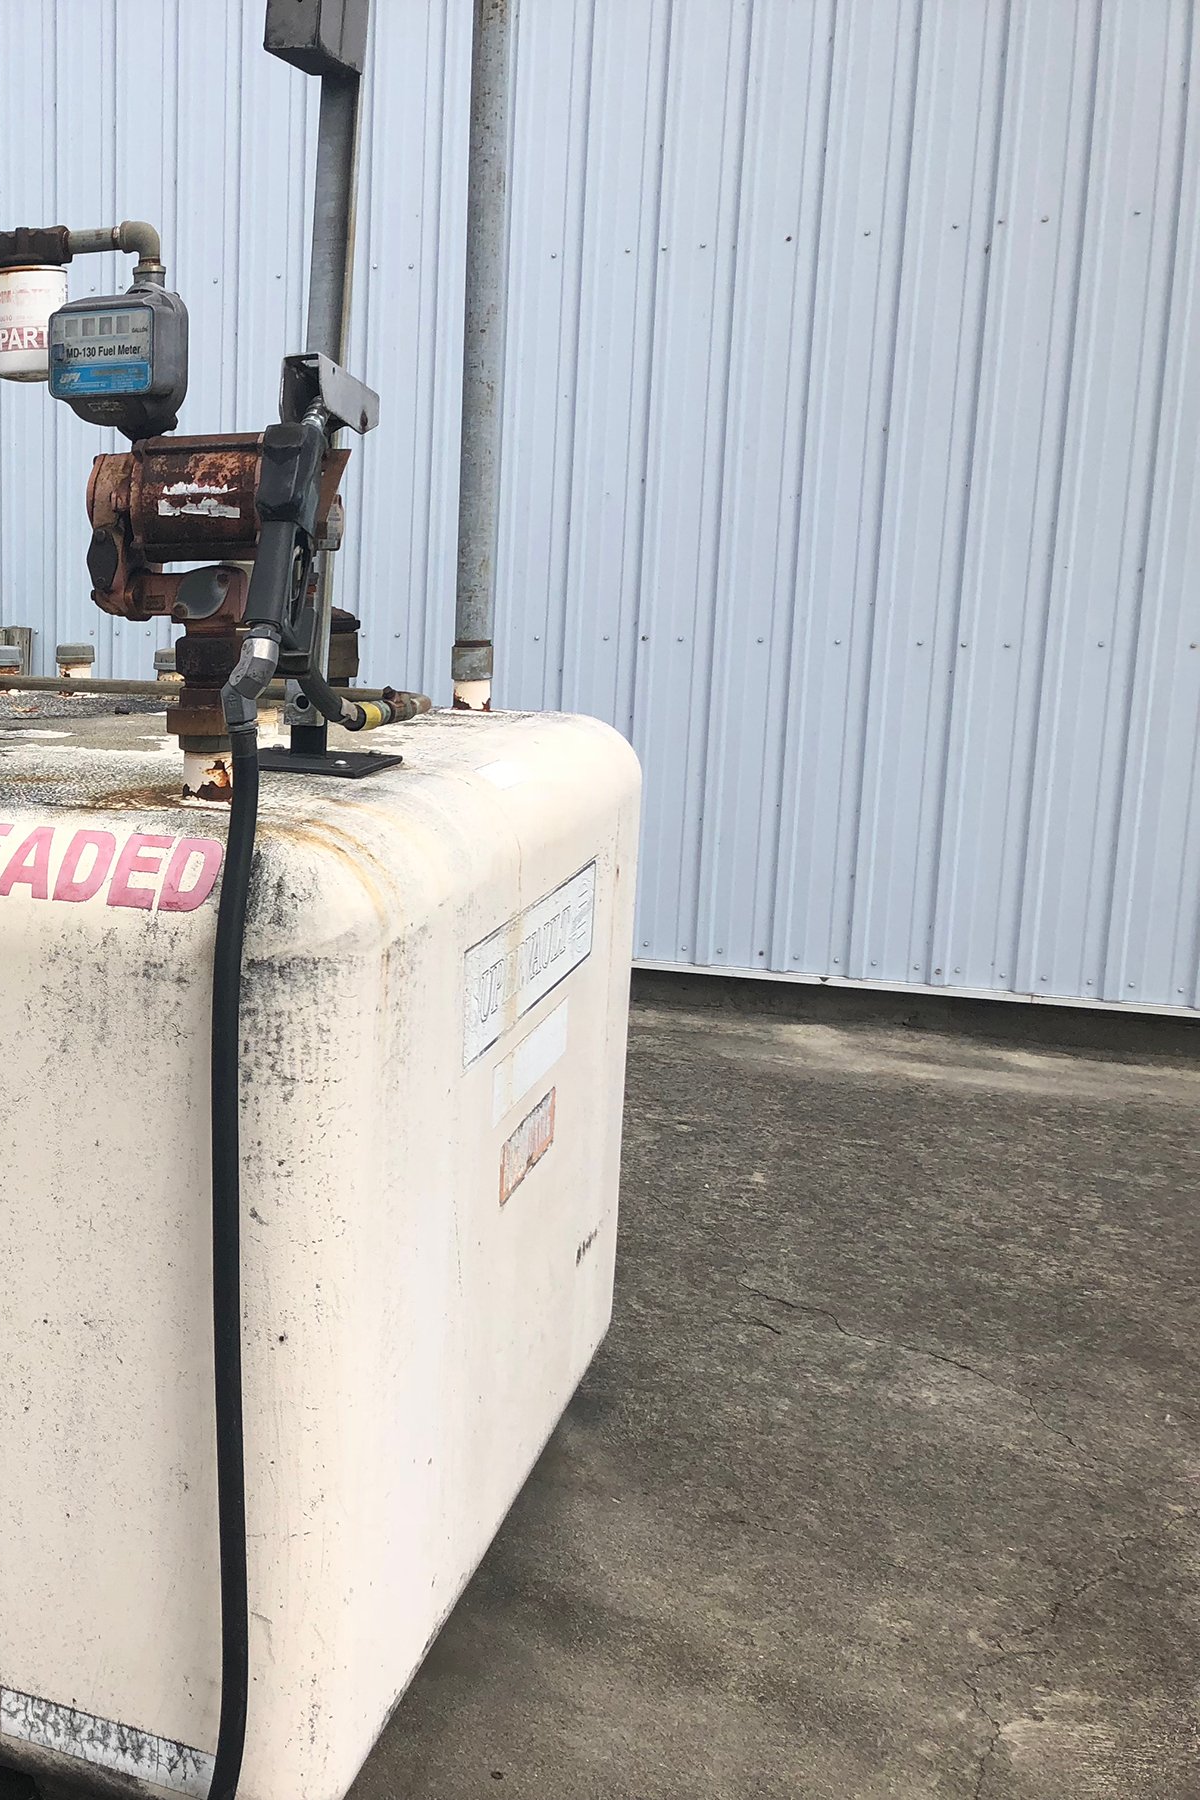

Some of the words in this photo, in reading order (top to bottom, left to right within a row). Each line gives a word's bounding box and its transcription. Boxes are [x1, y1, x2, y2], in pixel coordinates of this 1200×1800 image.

[66, 347, 96, 358] MD-130
[98, 346, 116, 356] Fuel
[118, 344, 141, 355] Meter
